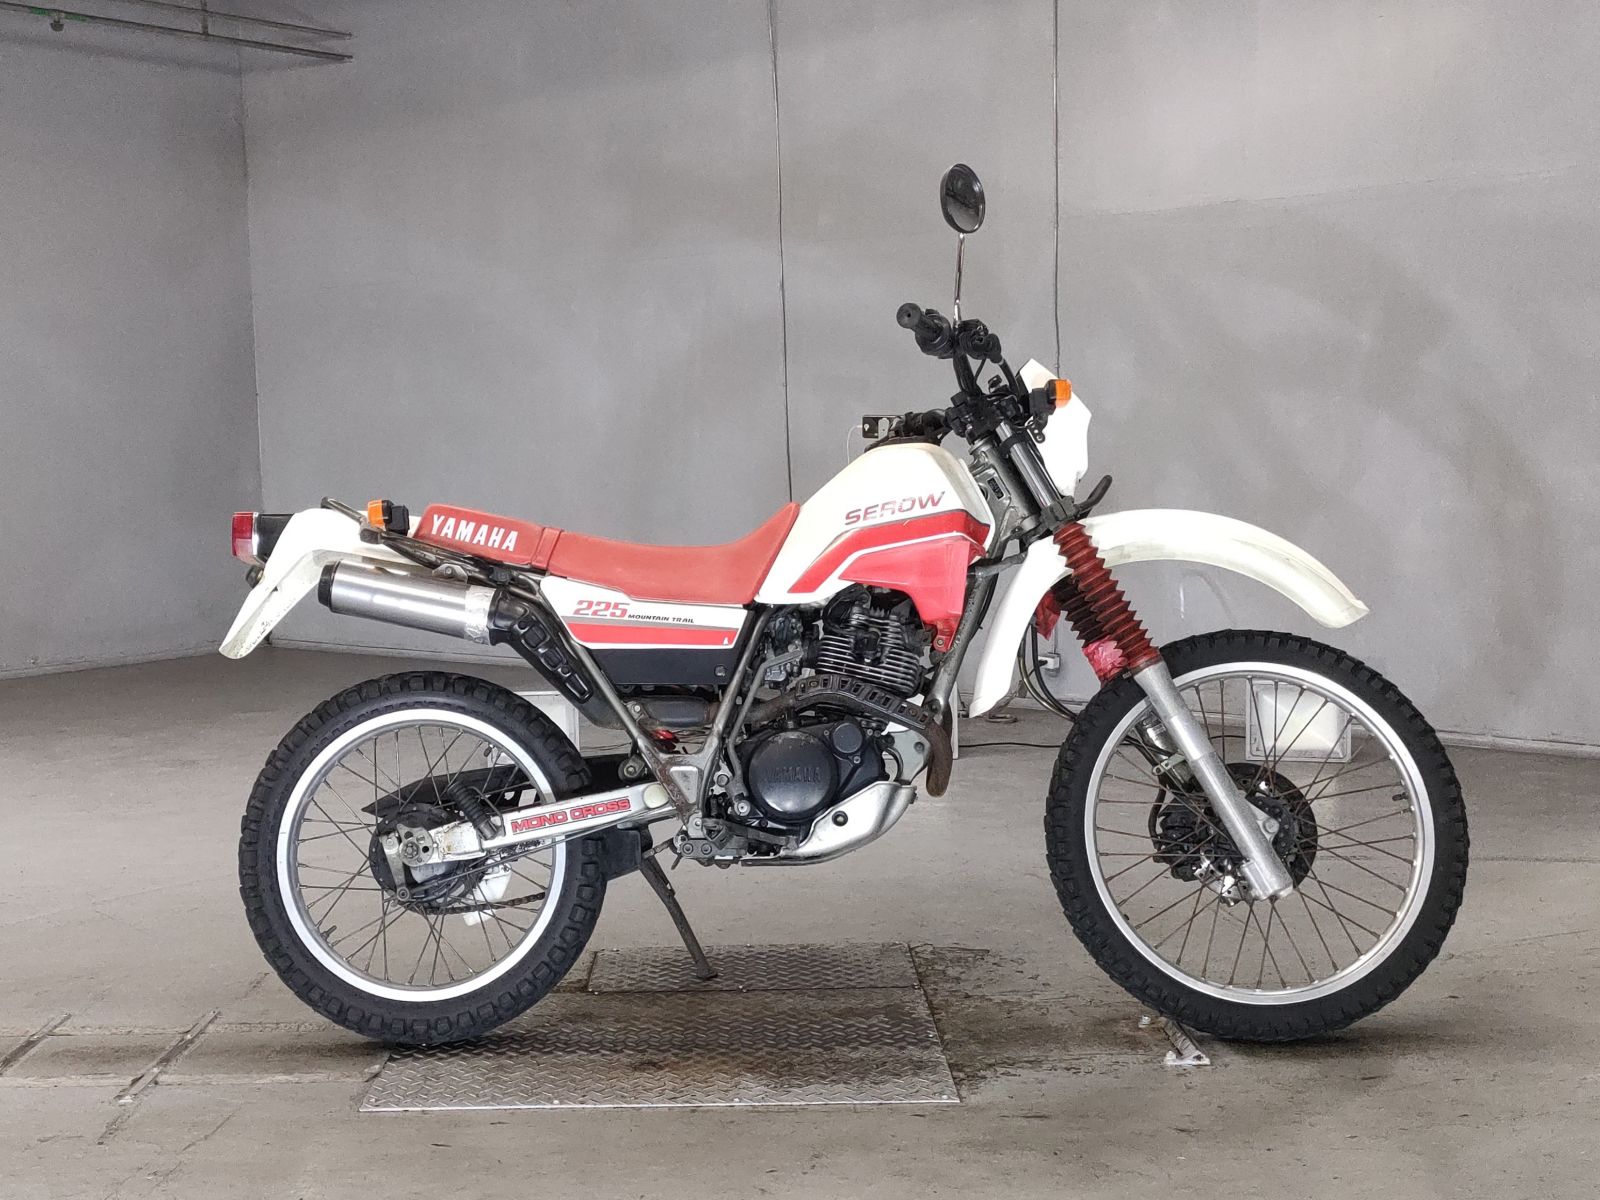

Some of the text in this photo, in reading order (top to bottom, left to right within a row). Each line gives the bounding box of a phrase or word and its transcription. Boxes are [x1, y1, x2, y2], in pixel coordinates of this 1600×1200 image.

[844, 490, 946, 526] SEROW
[431, 514, 518, 552] YAMAHA
[573, 599, 630, 618] 225
[628, 614, 669, 622] MOUNTAIN
[511, 798, 631, 833] MONO CROSS
